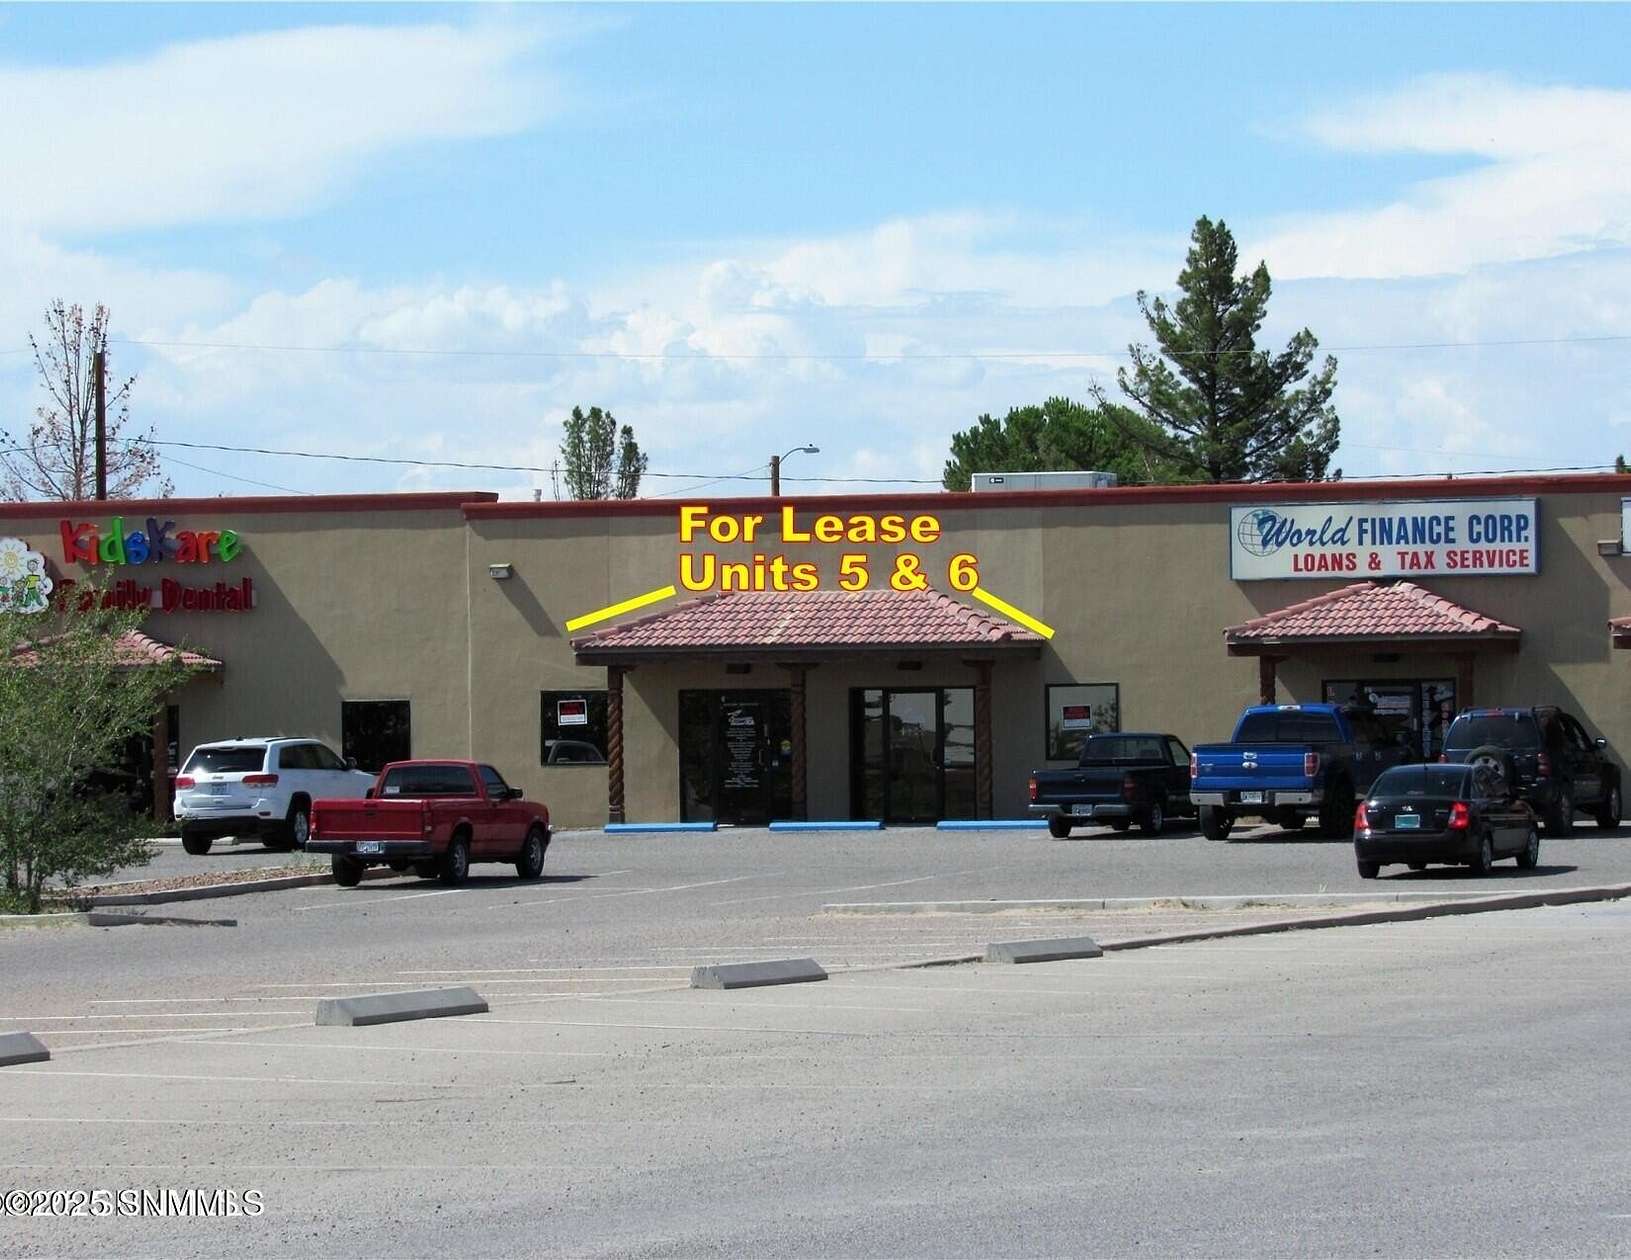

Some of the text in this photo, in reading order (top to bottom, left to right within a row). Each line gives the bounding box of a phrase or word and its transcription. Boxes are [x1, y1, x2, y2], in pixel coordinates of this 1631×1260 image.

[1258, 512, 1530, 548] World FINANCE CORP.
[1293, 549, 1530, 573] LOANS & TAX SERVICE
[161, 576, 253, 614] Dental
